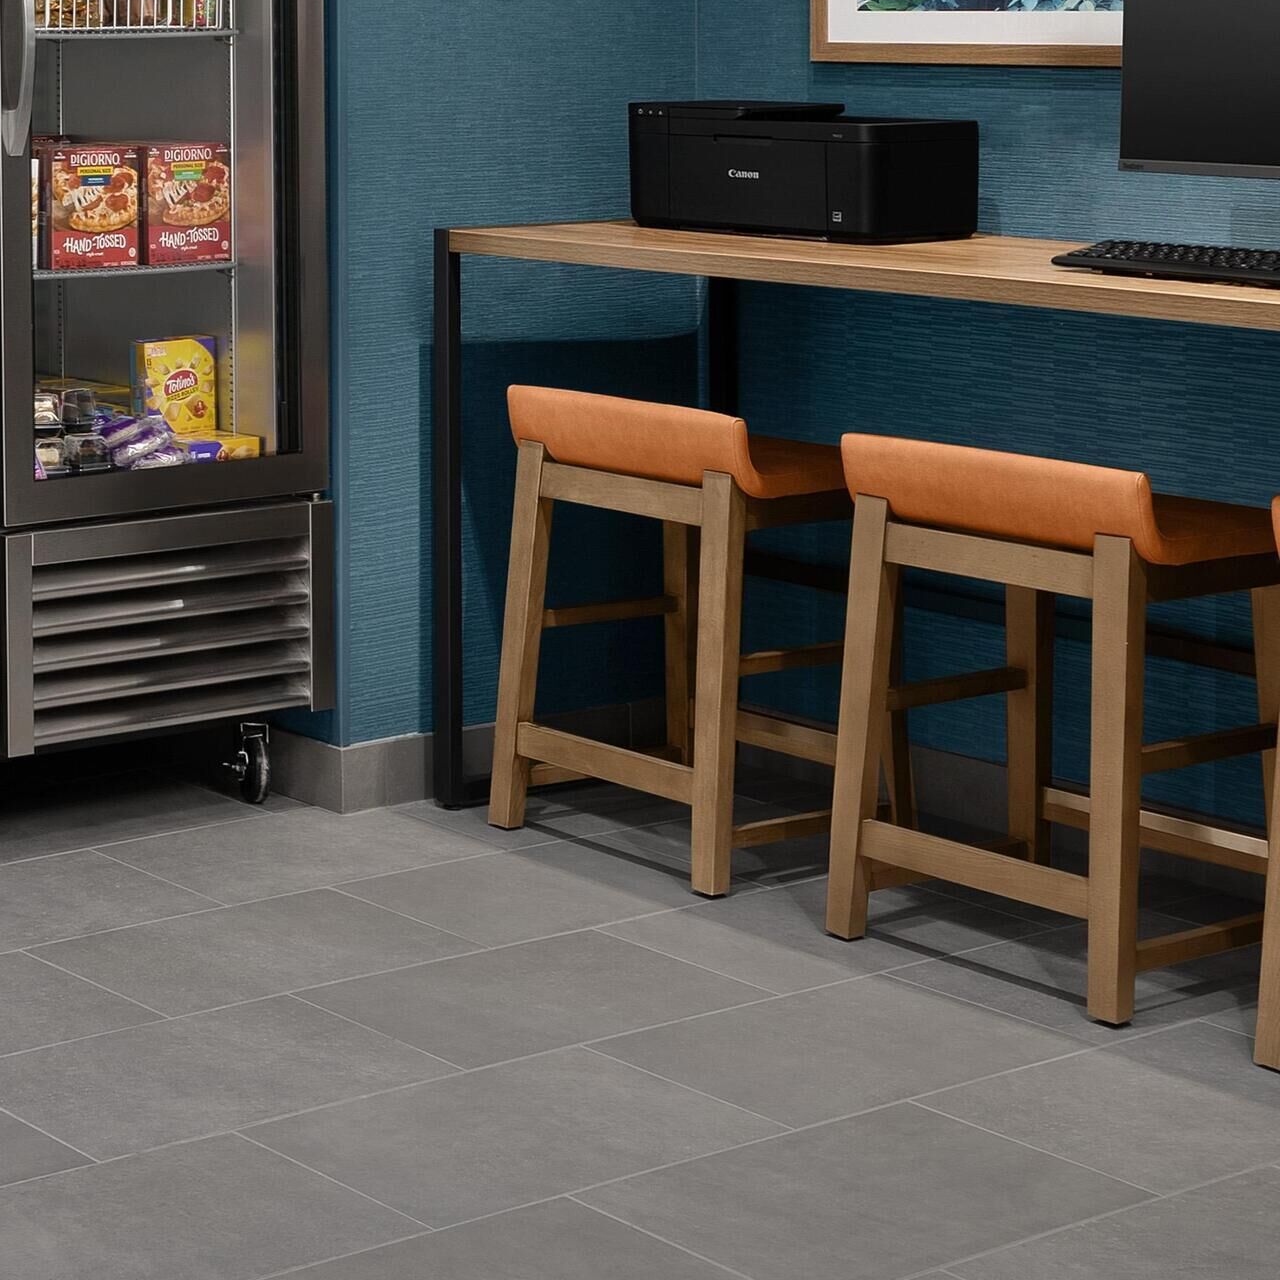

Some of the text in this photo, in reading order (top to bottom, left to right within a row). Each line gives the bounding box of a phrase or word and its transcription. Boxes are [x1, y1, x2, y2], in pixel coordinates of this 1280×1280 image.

[728, 169, 759, 179] Canon
[63, 233, 127, 253] HAND-TOSSED
[159, 227, 219, 249] HAND-TOSSED
[165, 374, 196, 394] Totino's
